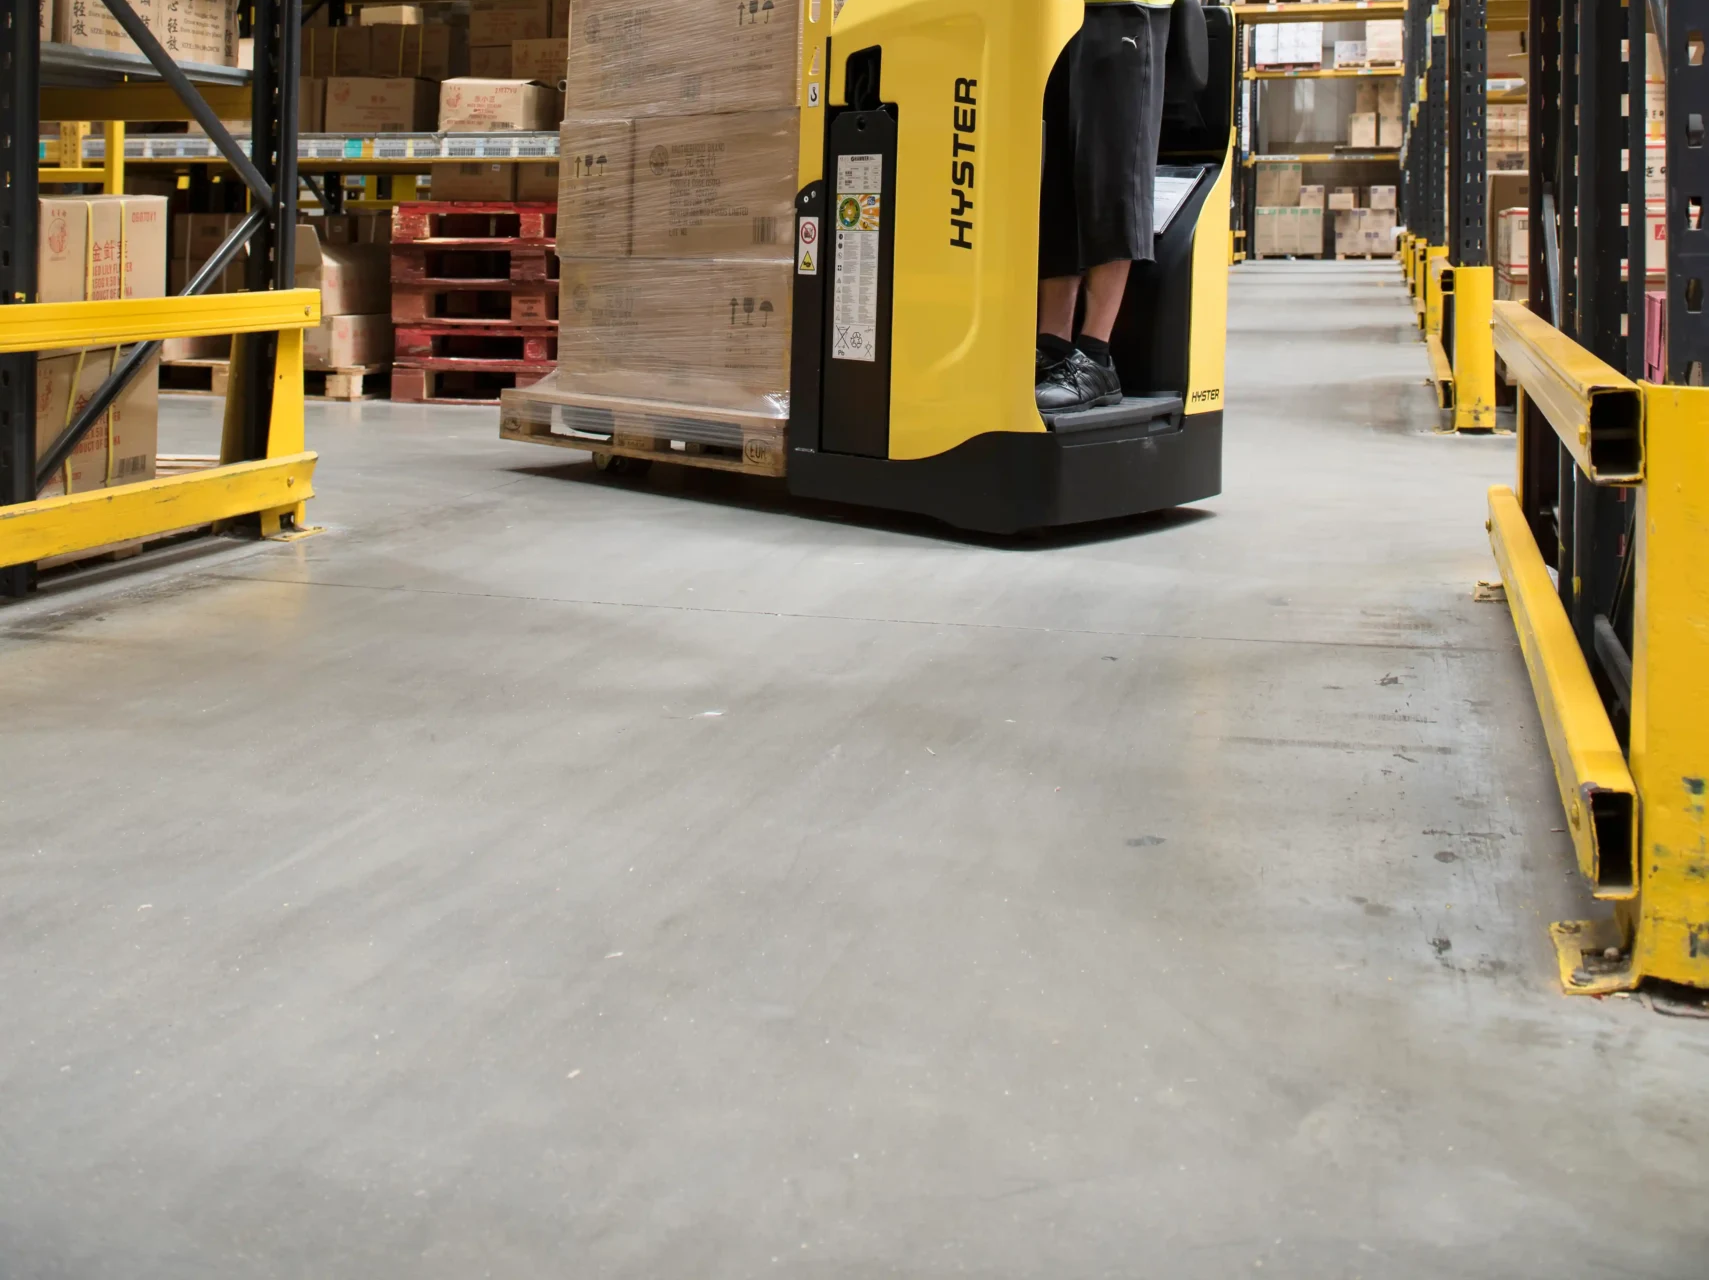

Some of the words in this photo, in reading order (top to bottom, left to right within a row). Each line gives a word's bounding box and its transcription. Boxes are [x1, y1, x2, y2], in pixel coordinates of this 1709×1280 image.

[707, 142, 725, 153] BRAND
[950, 77, 977, 250] HYSTER
[1192, 389, 1220, 402] HYSTER
